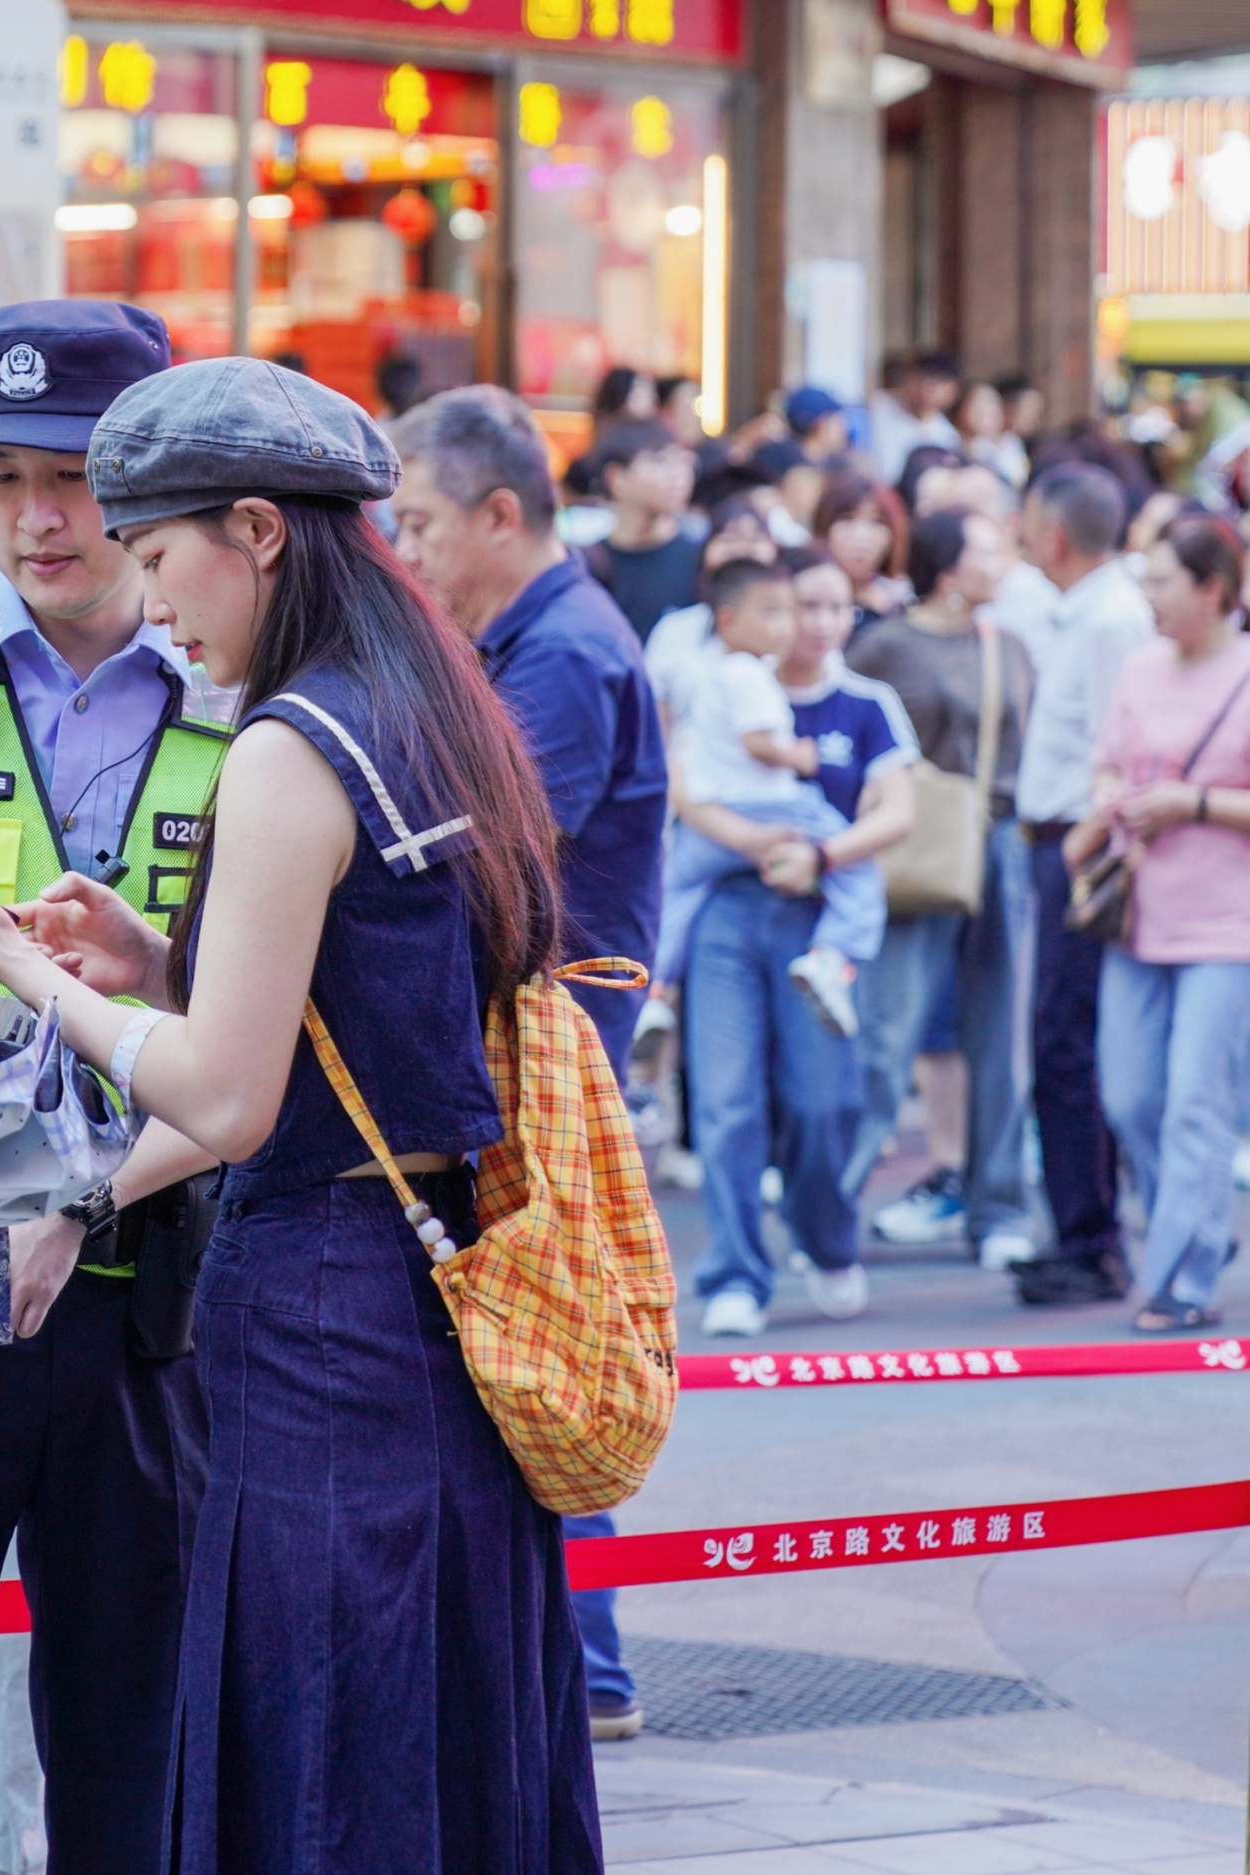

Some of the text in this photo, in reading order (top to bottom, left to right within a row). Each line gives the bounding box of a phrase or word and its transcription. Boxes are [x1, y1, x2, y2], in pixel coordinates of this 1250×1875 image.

[789, 1350, 1021, 1382] 北京路文化旅游区
[772, 1511, 1046, 1563] 北京路文化旅游区
